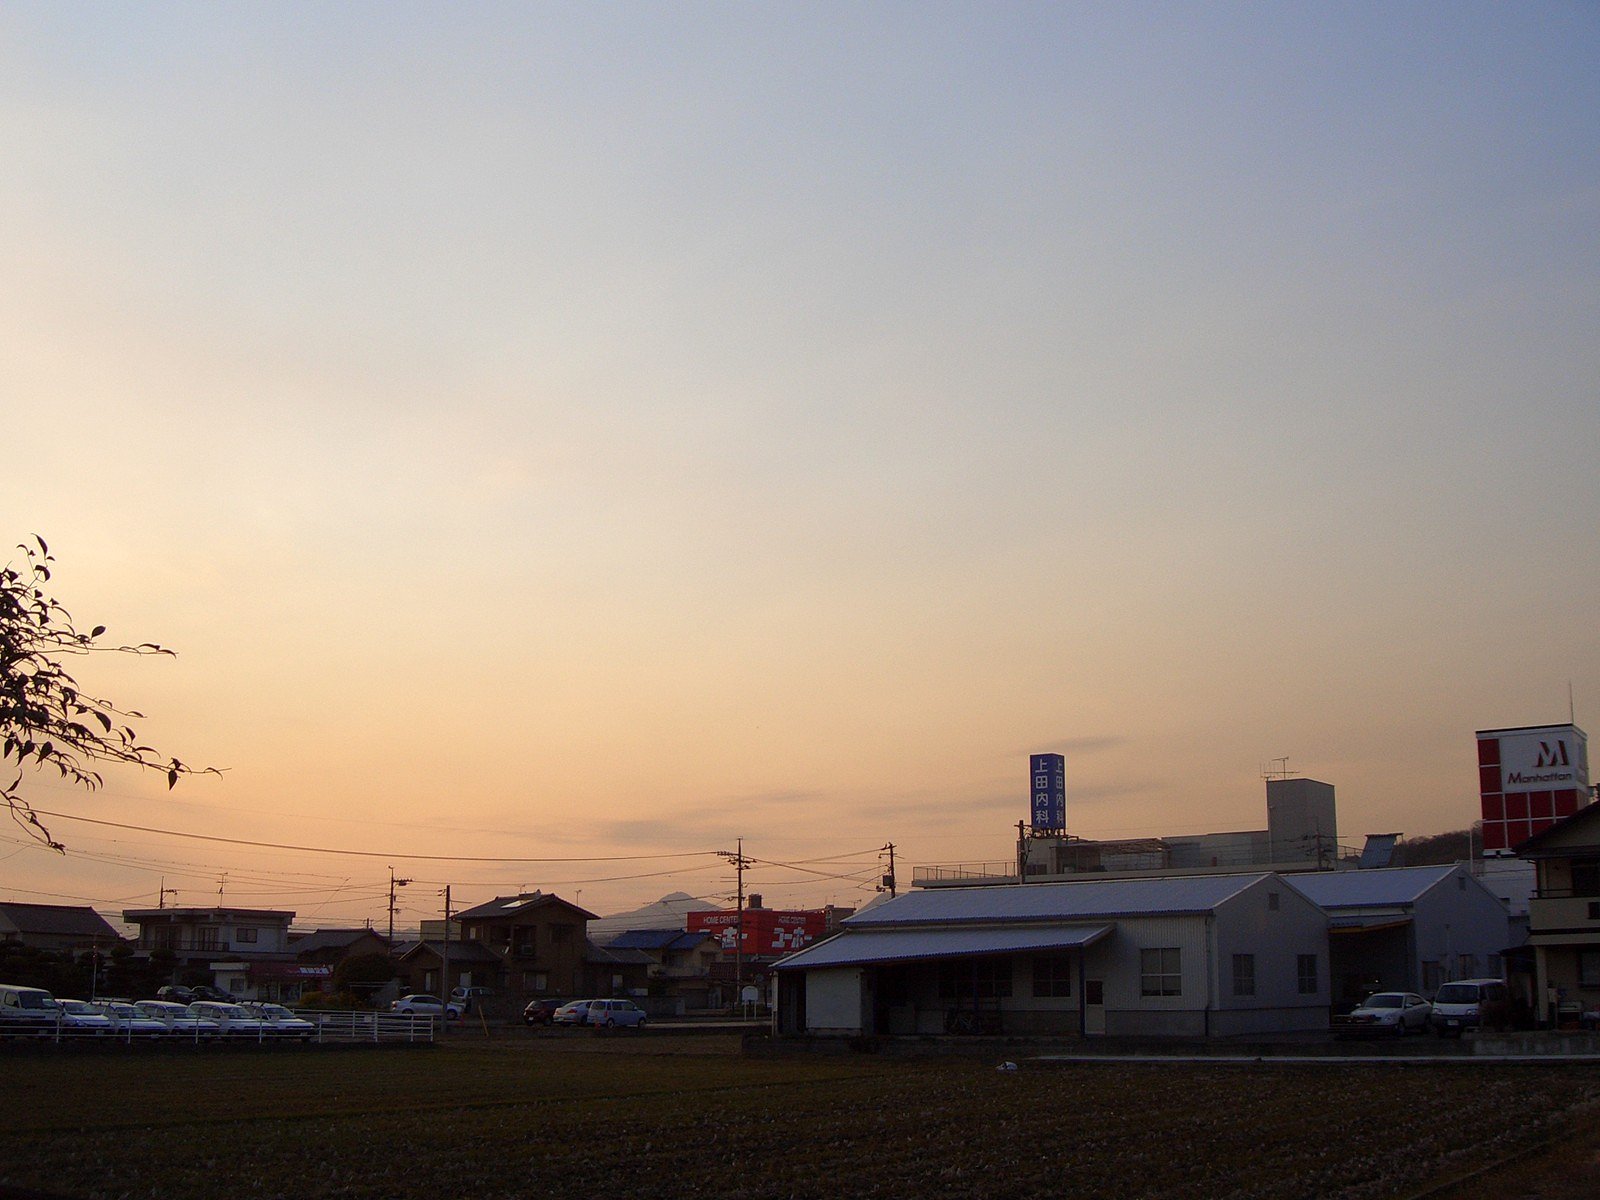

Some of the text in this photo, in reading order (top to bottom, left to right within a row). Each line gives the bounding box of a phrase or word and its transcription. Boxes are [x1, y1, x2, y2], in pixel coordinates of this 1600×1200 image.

[1508, 772, 1572, 785] Manhattan
[1035, 758, 1049, 824] 上田内科
[703, 915, 739, 924] HOME CENTE
